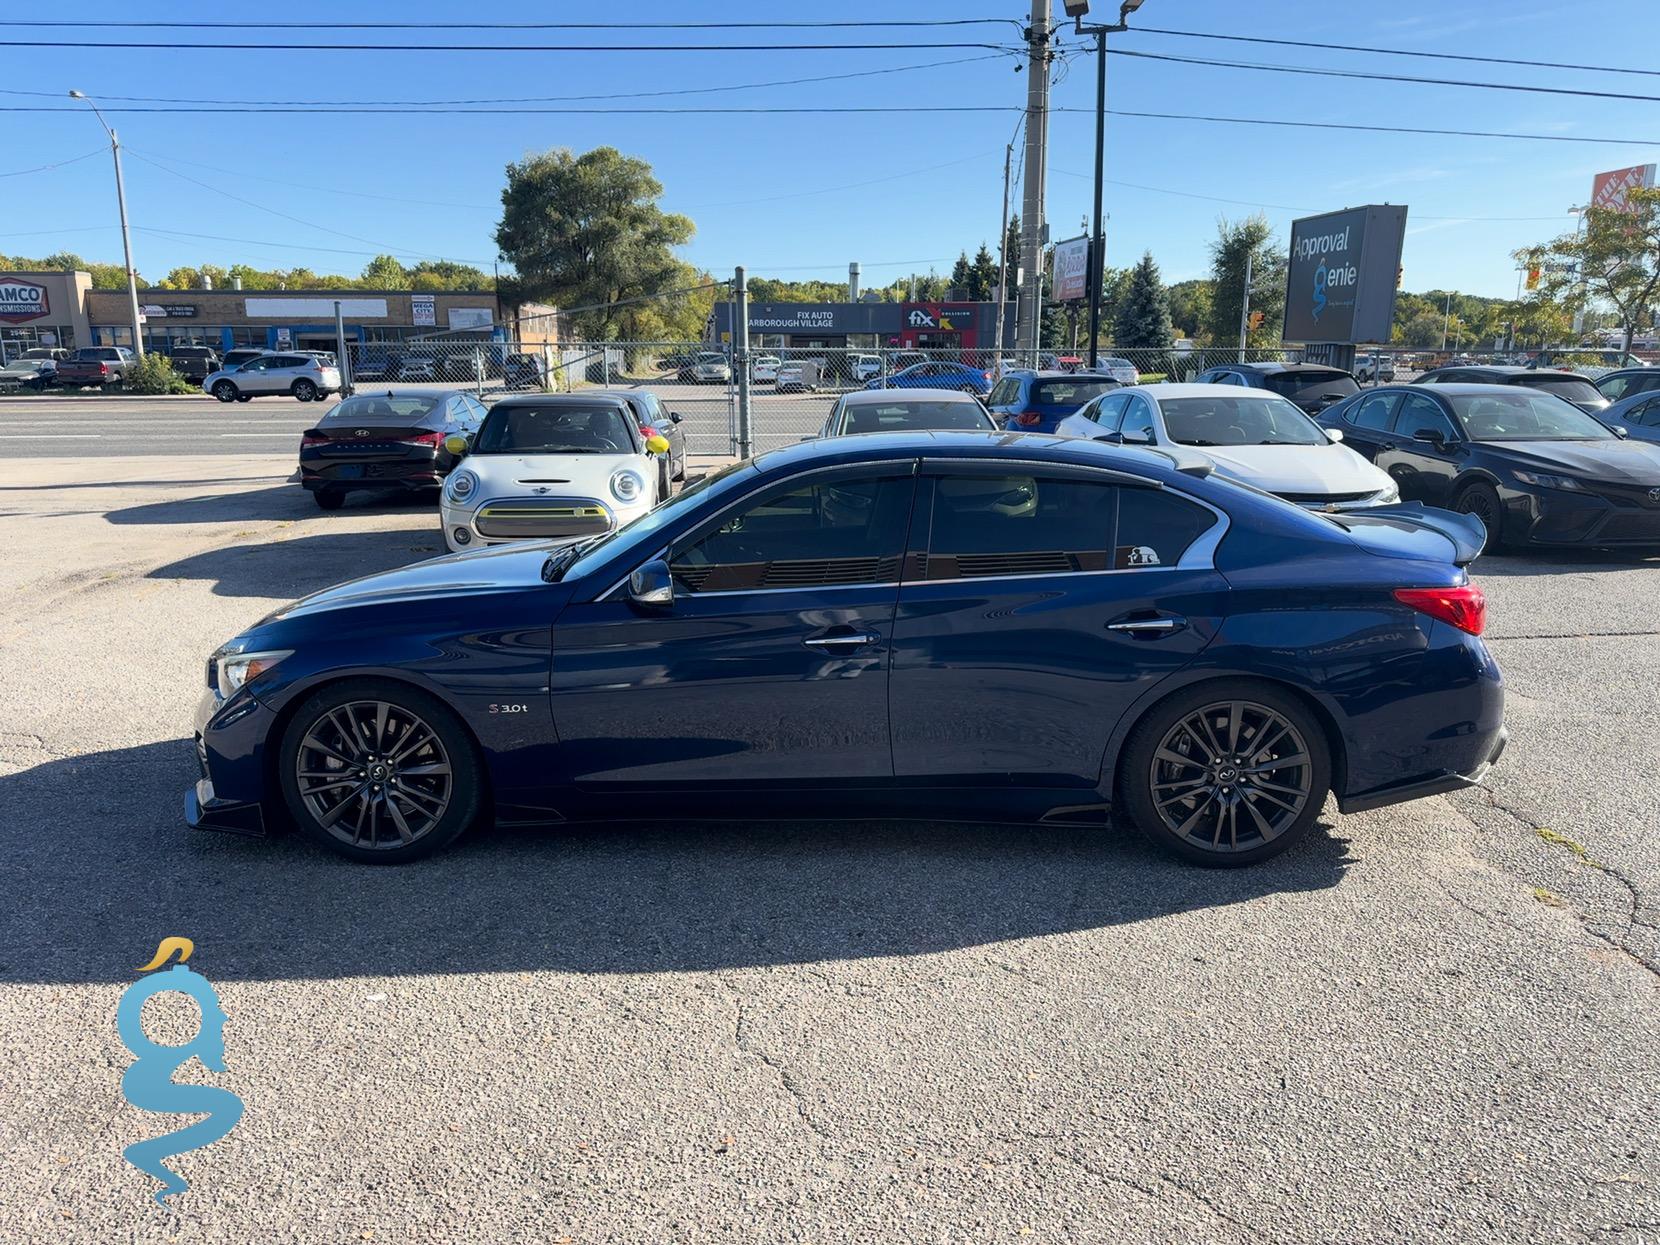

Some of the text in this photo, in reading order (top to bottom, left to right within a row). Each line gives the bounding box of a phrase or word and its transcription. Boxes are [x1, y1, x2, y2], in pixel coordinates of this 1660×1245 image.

[1292, 225, 1350, 262] Approval
[797, 311, 833, 319] FIX AUTO
[908, 310, 936, 327] fix
[748, 319, 833, 327] ARBOROUGH VILLAGE
[488, 703, 499, 714] S
